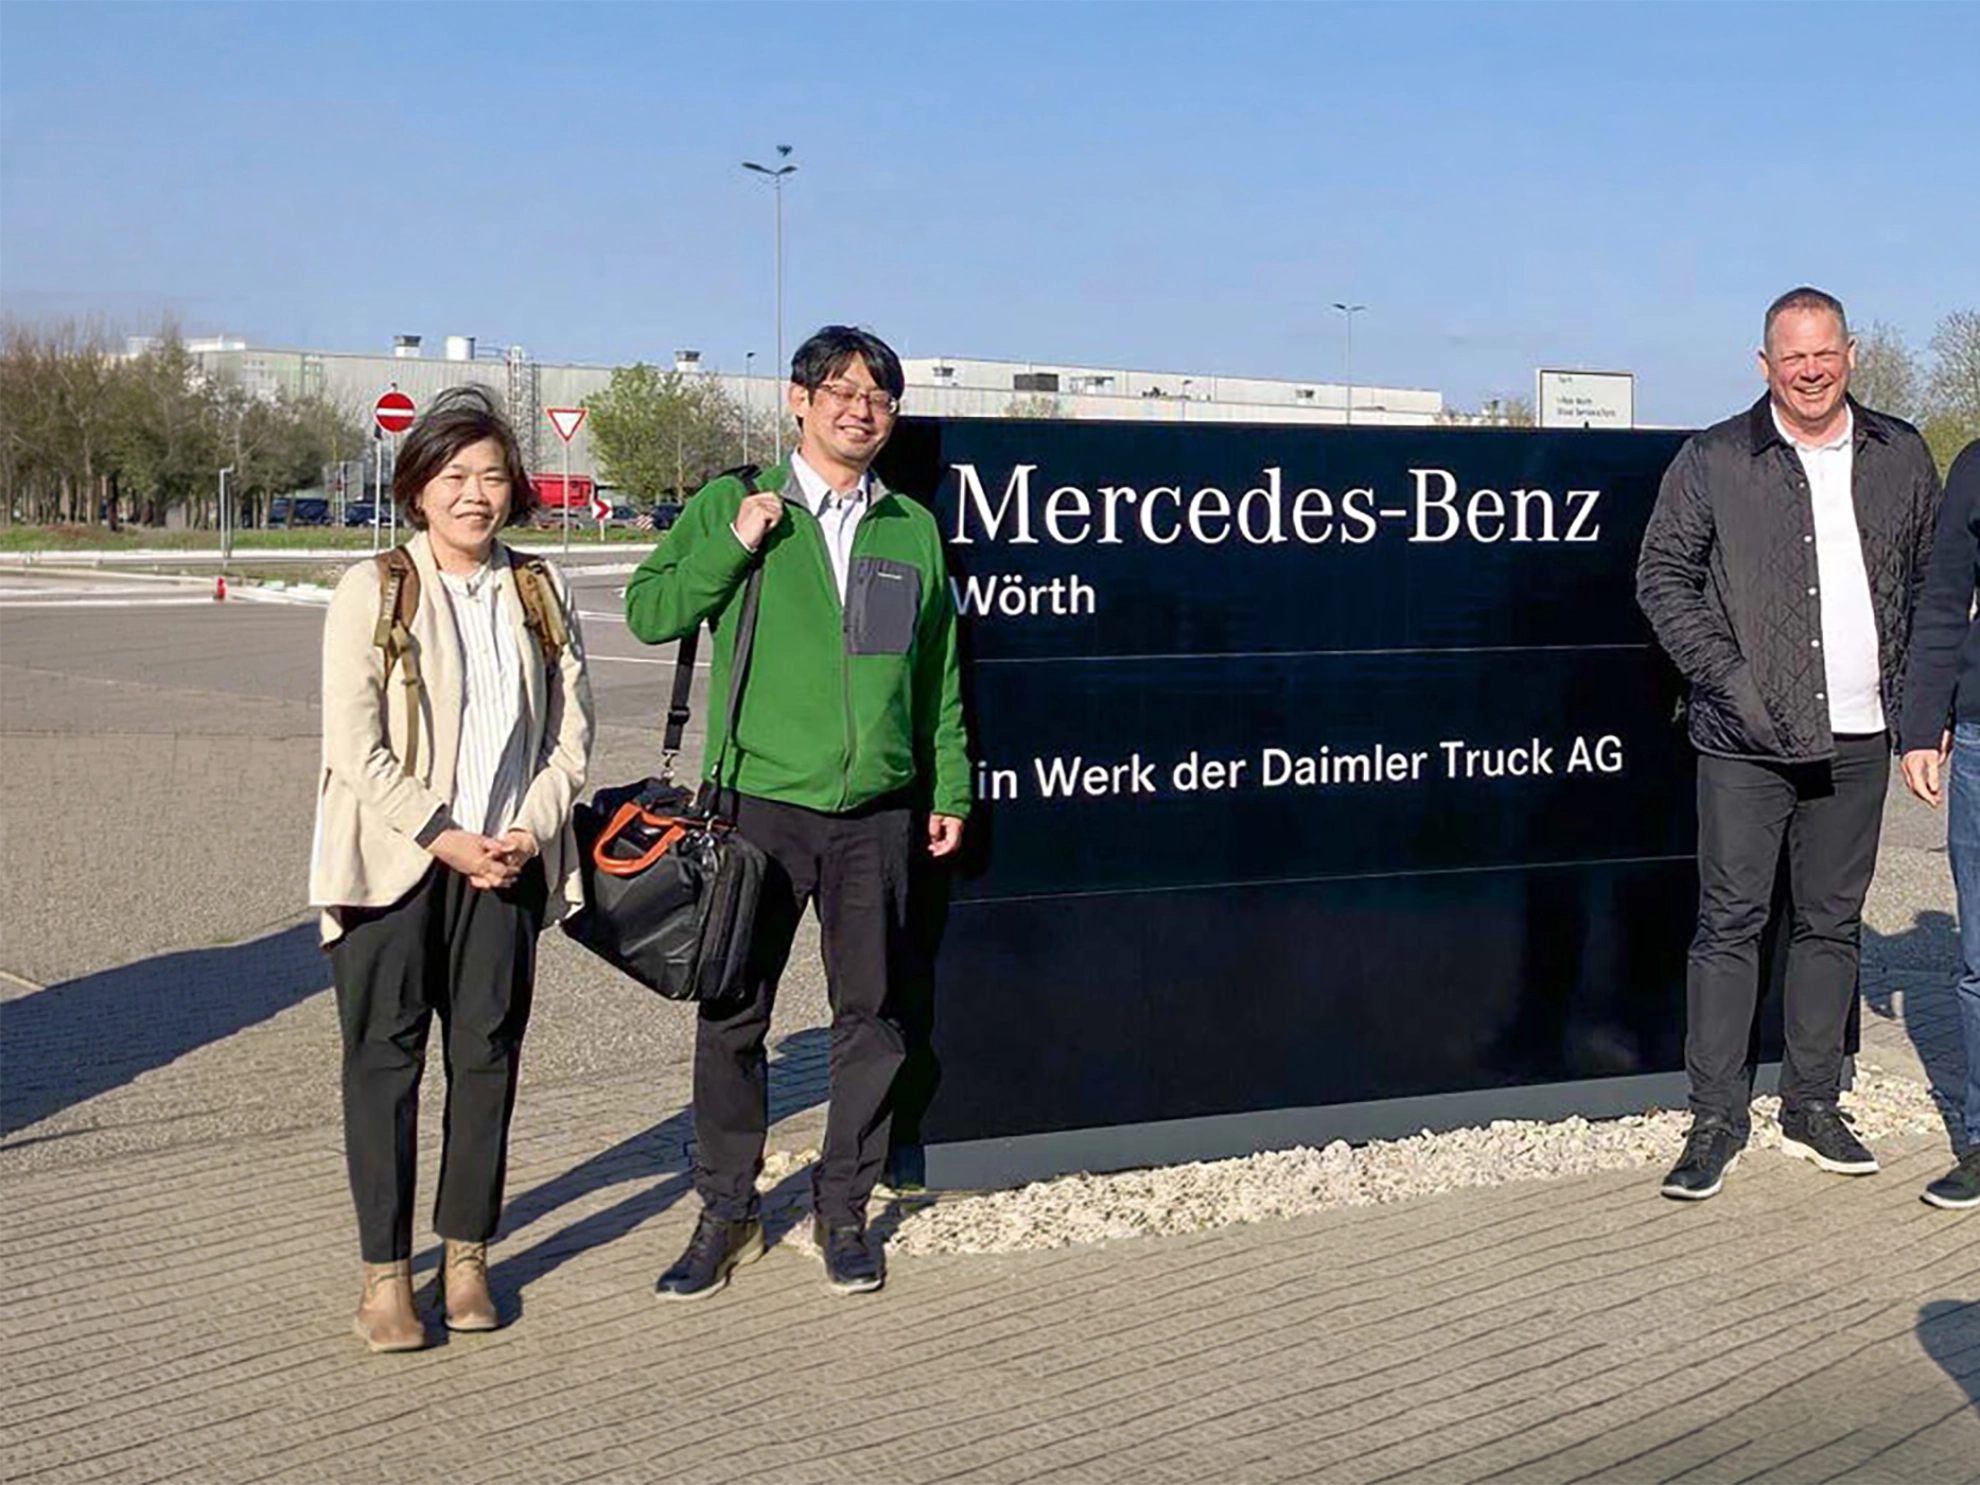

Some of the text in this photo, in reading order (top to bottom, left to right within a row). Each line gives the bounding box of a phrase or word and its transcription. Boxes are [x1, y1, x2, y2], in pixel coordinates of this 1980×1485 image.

[950, 463, 1601, 545] Mercedes-Benz
[950, 574, 1095, 616] Wörth
[977, 734, 1623, 800] in Werk der Daimler Truck AG
